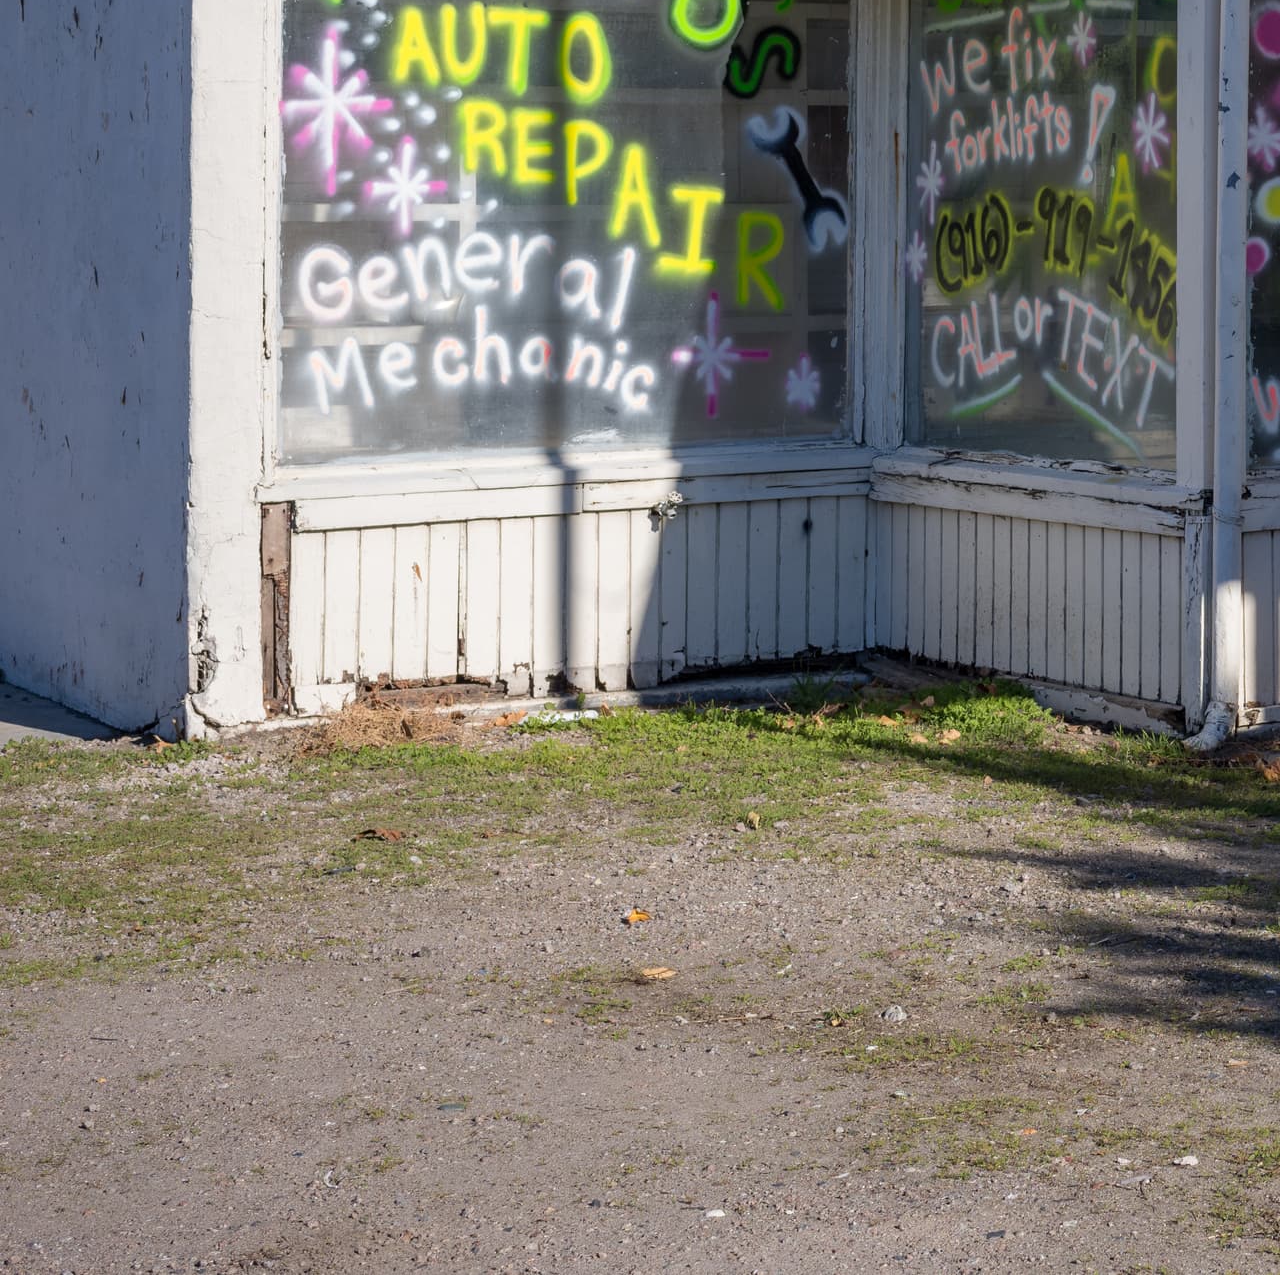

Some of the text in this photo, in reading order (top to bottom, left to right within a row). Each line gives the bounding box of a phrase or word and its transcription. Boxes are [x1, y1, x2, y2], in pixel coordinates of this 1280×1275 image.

[392, 1, 614, 104] AUTO
[919, 6, 1058, 116] We fix
[456, 100, 787, 313] REPAIR
[299, 227, 636, 333] General
[304, 302, 656, 414] Mechanic
[931, 288, 1177, 430] CALL or TEXT
